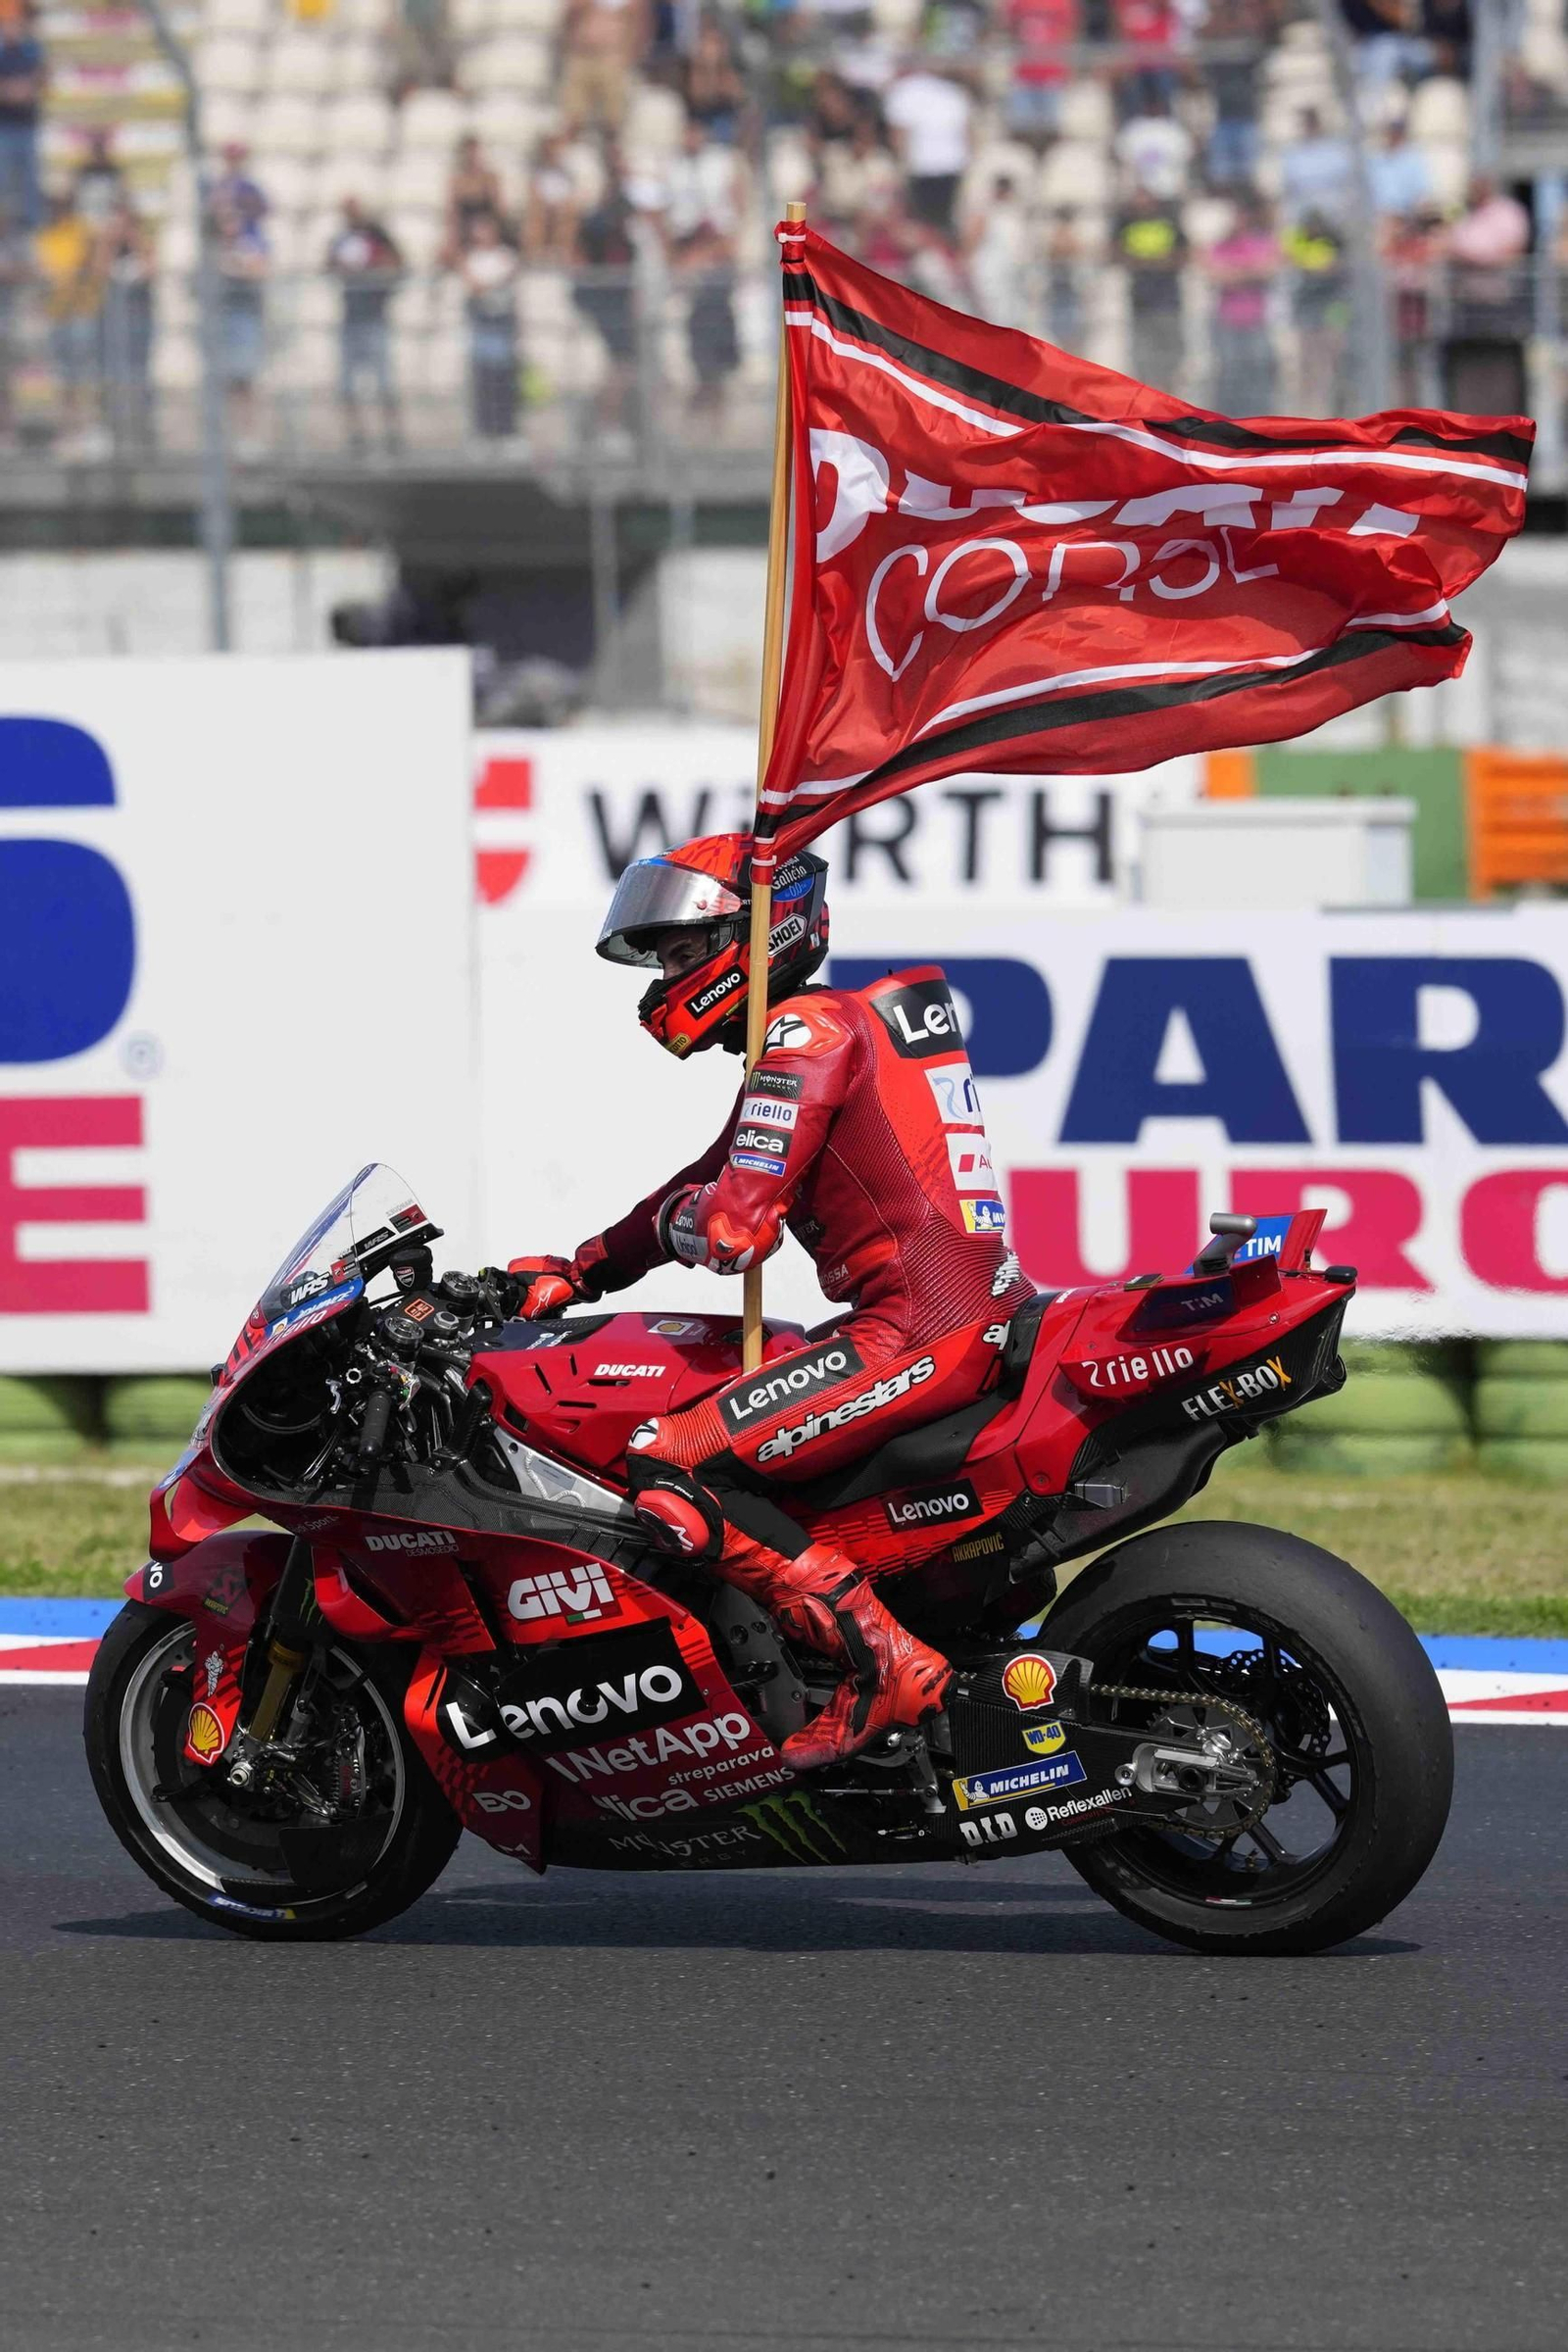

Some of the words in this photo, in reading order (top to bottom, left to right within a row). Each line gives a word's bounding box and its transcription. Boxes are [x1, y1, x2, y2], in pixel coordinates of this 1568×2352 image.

[586, 784, 1114, 887] WRTH
[691, 973, 741, 1012] Lenovo
[893, 1001, 958, 1045] Len
[828, 956, 1568, 1145] PAR
[760, 1074, 798, 1087] MONSTER
[751, 1102, 792, 1121] riello
[736, 1130, 783, 1153] elica
[738, 1157, 780, 1171] MICHELIN
[1245, 1235, 1282, 1257] TIM
[290, 1273, 330, 1305] WRS
[1181, 1293, 1224, 1311] TIM
[594, 1363, 666, 1377] DUCATI
[1106, 1347, 1194, 1386] riello
[729, 1350, 847, 1420] Lenovo
[1181, 1355, 1292, 1421] FLEX-BOX
[758, 1355, 936, 1463] alpinestars
[888, 1494, 969, 1523] Lenovo
[365, 1531, 457, 1551] DUCATI
[508, 1562, 614, 1620] GIVI
[446, 1665, 683, 1749] Lenovo
[1026, 1725, 1060, 1746] WD-40
[667, 1745, 775, 1787] streparava
[990, 1764, 1069, 1794] MICHELIN
[703, 1767, 796, 1803] SIEMENS
[1047, 1785, 1133, 1822] Reflexallen
